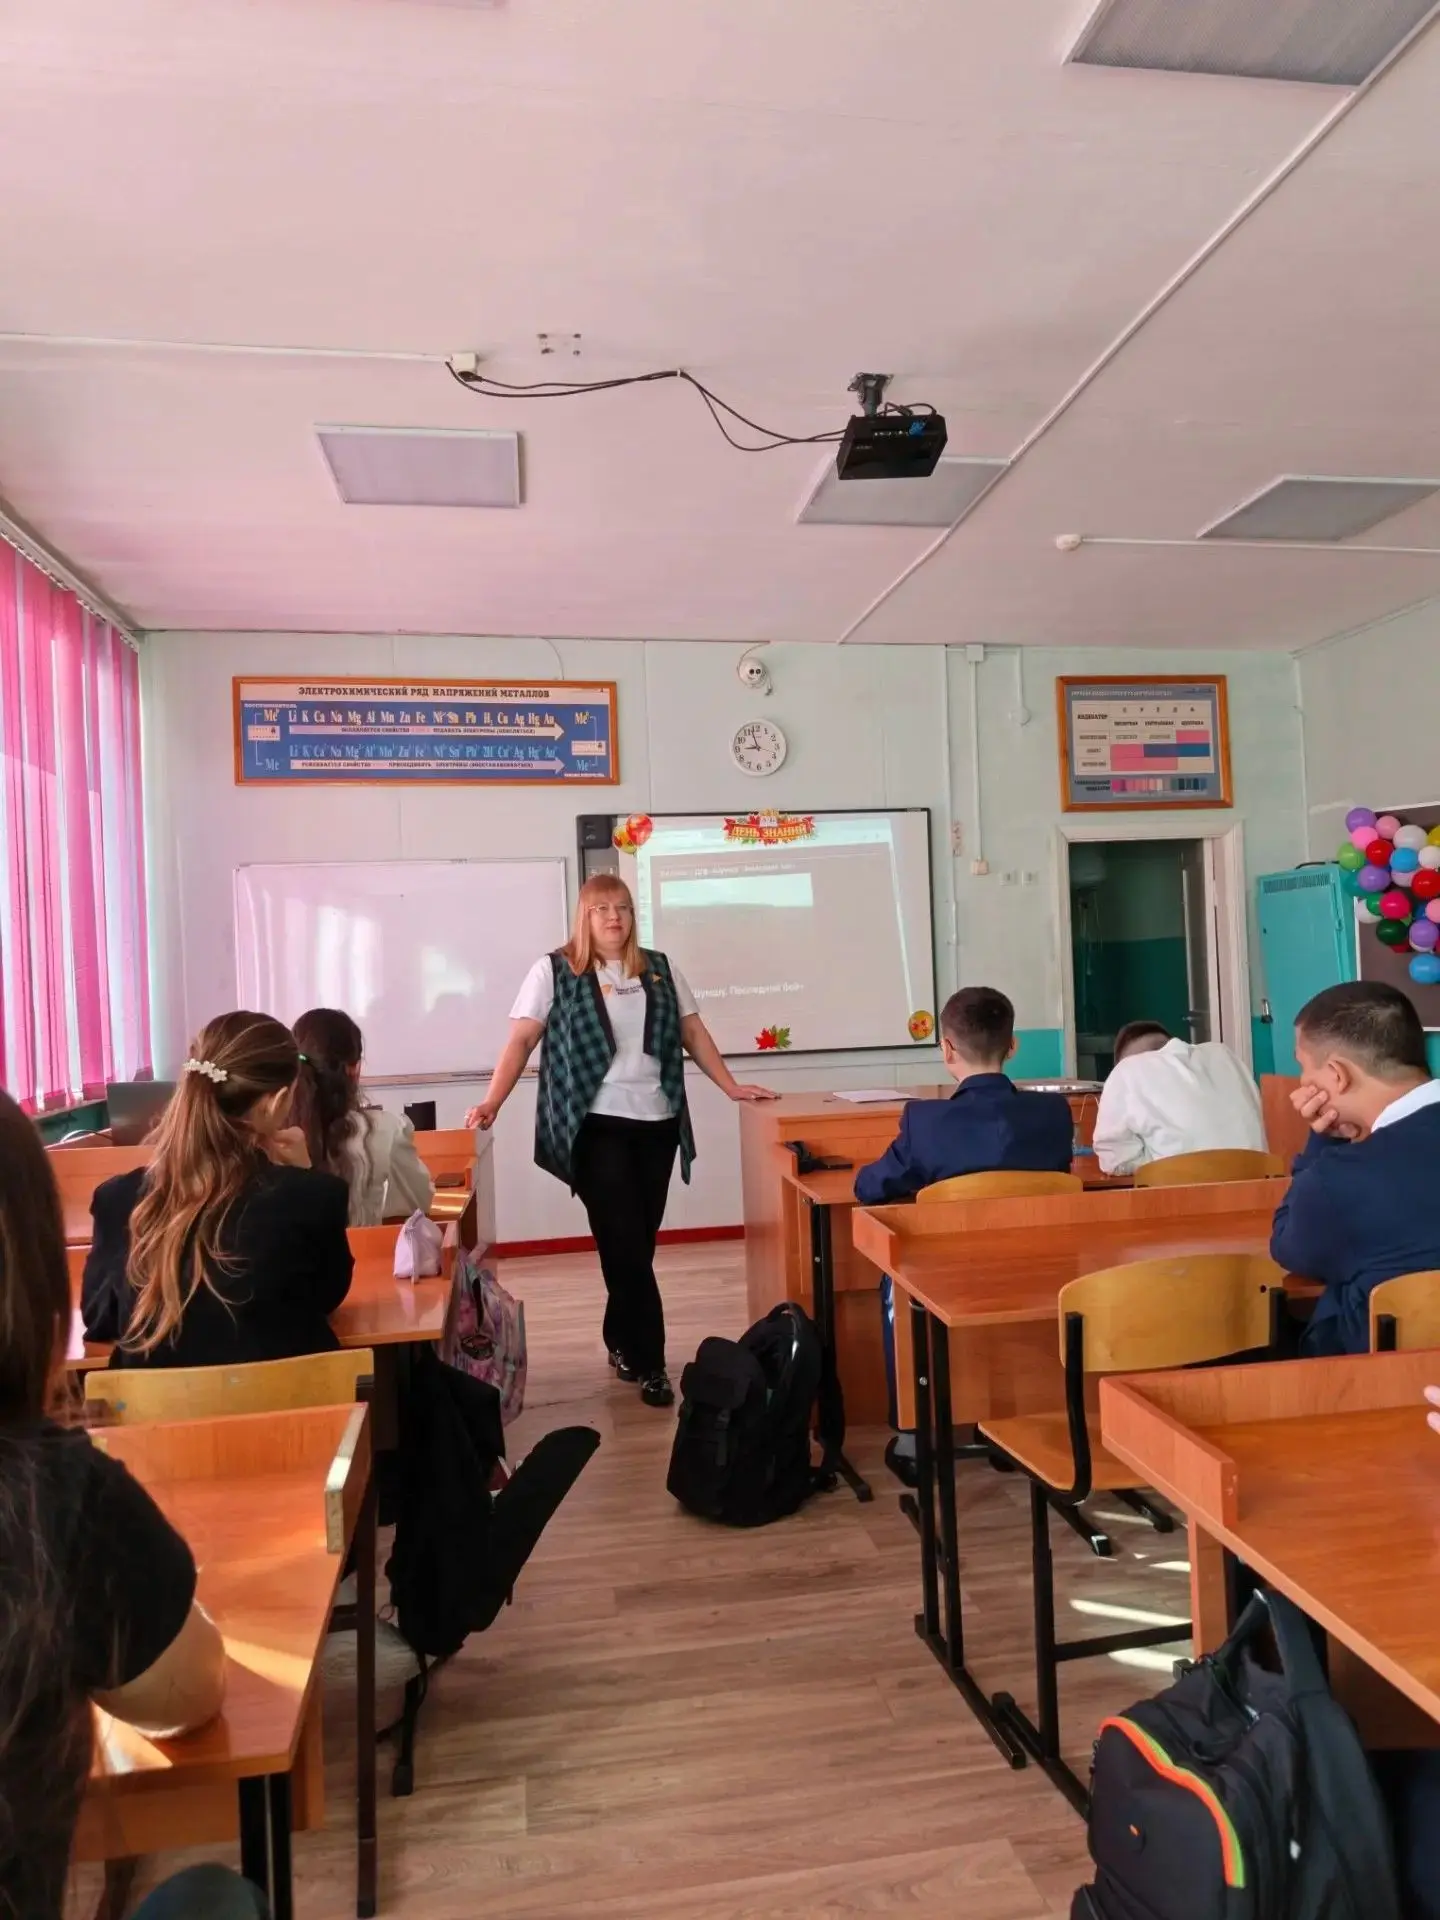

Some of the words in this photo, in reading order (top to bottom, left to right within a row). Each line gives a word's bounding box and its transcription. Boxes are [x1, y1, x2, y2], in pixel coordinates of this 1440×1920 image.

[298, 686, 408, 696] ЭЛЕКТРОХИМИЧЕСКИЙ
[410, 688, 429, 696] РЯД
[432, 688, 498, 697] НАПРЯЖЕНИЙ
[500, 689, 550, 698] МЕТАЛЛОВ
[288, 709, 298, 723] Li
[302, 709, 309, 723] K
[313, 709, 326, 723] Ca
[330, 709, 343, 723] Na
[347, 709, 362, 726] Mg
[366, 710, 376, 723] Al
[381, 710, 395, 724] Mn
[399, 710, 411, 724] Zn
[415, 711, 426, 724] Fe
[465, 711, 477, 725] Pb
[497, 711, 509, 725] Cu
[543, 711, 555, 725] Au
[731, 826, 760, 838] ДЕНЬ
[762, 823, 807, 838] ЗНАНИЙ
